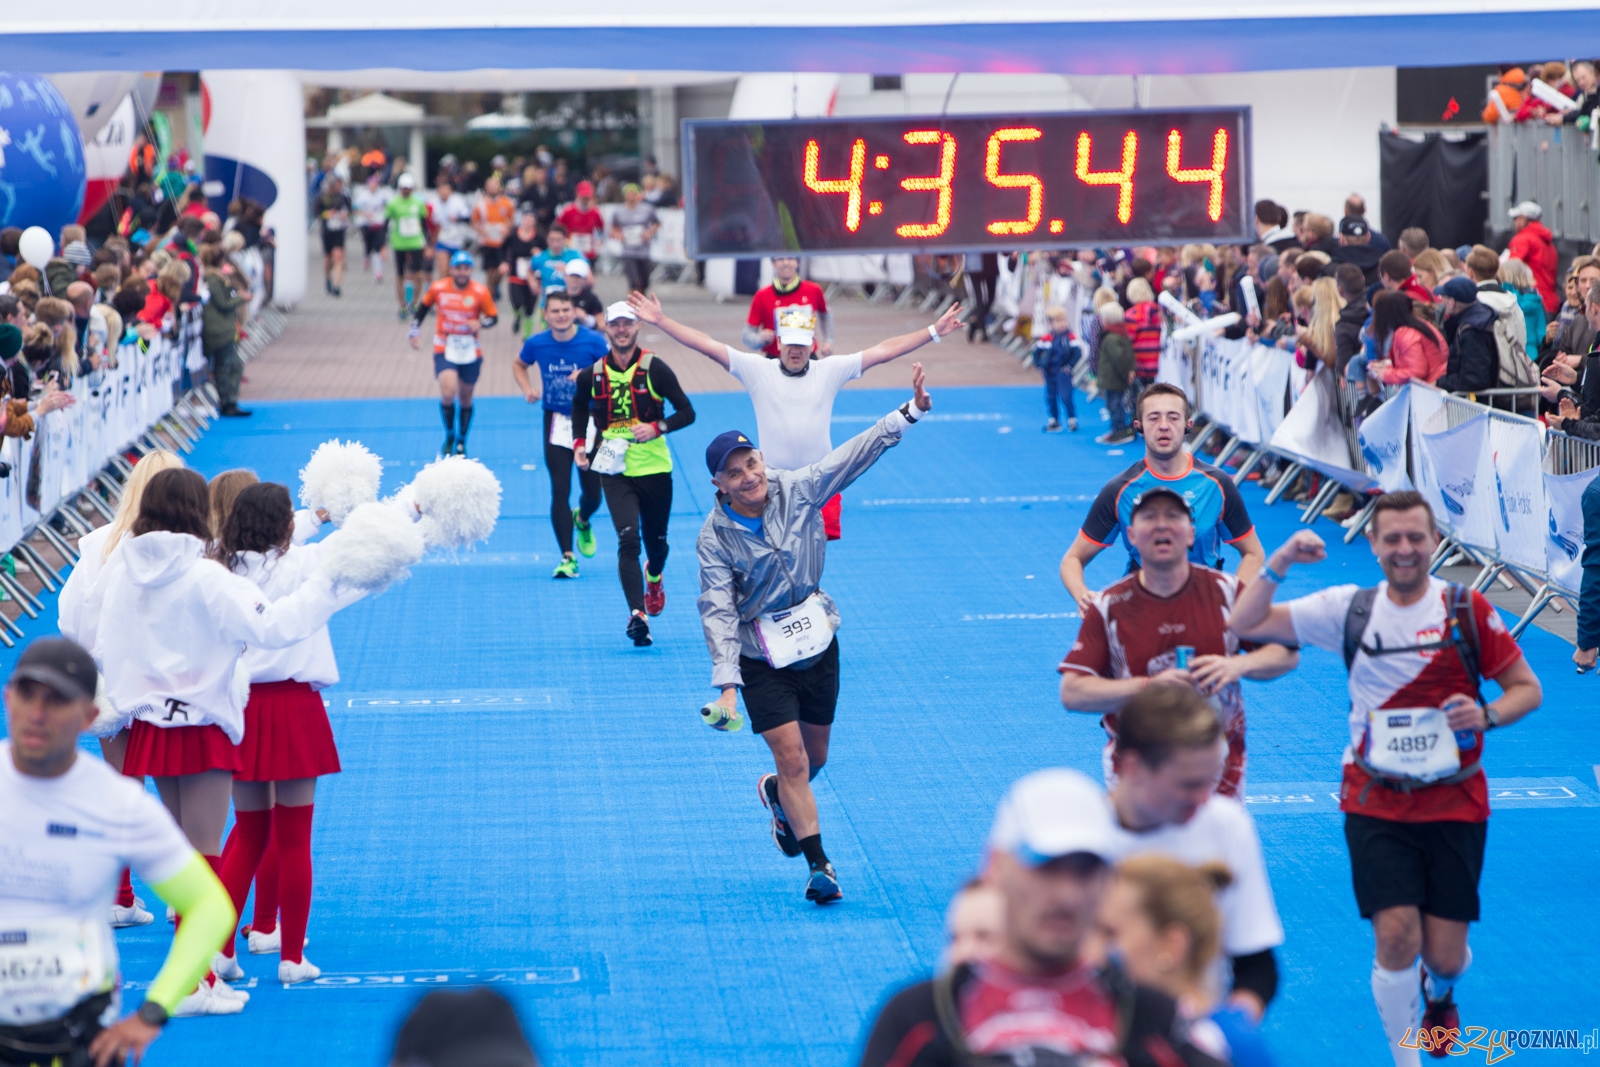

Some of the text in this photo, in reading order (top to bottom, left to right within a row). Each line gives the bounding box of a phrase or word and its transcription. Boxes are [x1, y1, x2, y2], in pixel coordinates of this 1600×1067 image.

[803, 127, 1228, 238] 4:35.44
[782, 617, 812, 638] 393
[1387, 733, 1439, 753] 4887
